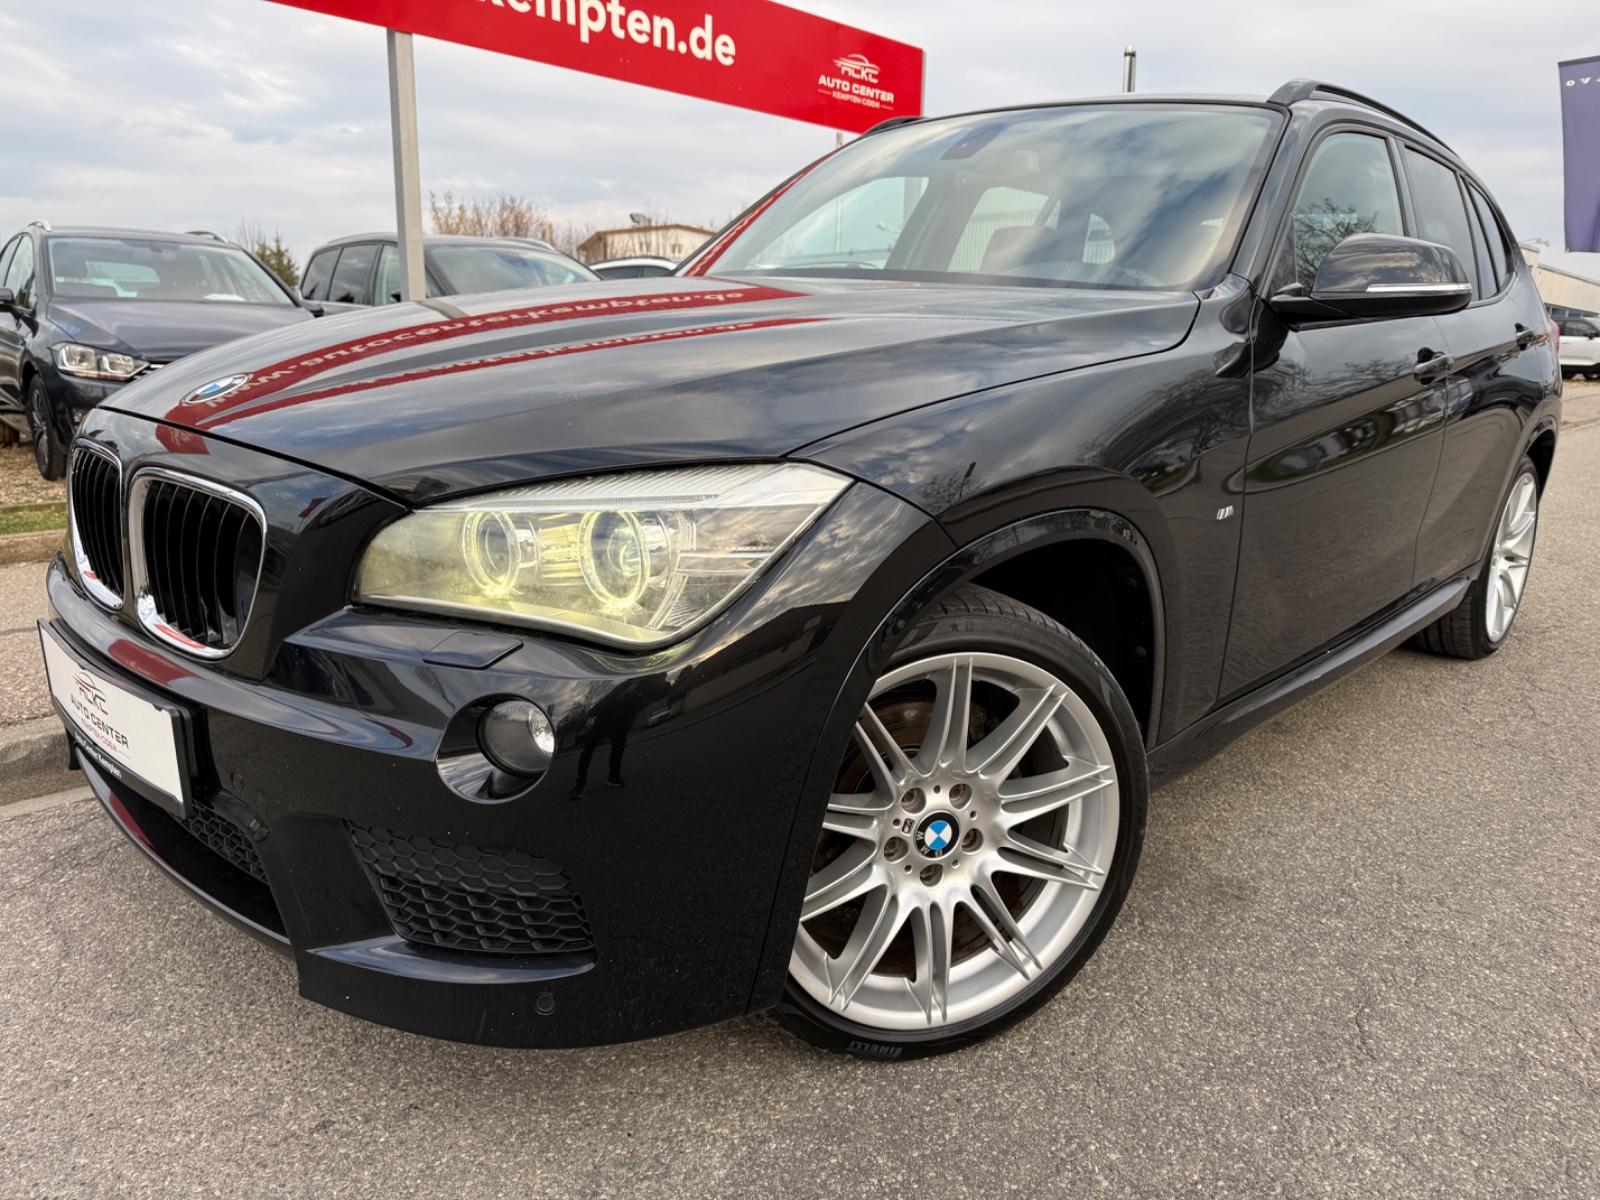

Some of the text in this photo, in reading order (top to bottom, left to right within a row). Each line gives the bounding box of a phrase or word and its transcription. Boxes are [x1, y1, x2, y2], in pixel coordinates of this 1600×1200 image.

[478, 0, 736, 66] mpten.de
[818, 75, 894, 103] AUTO CENTER
[70, 693, 90, 720] AUTO
[90, 713, 130, 749] CENTER
[849, 1040, 904, 1058] PIRELLI
